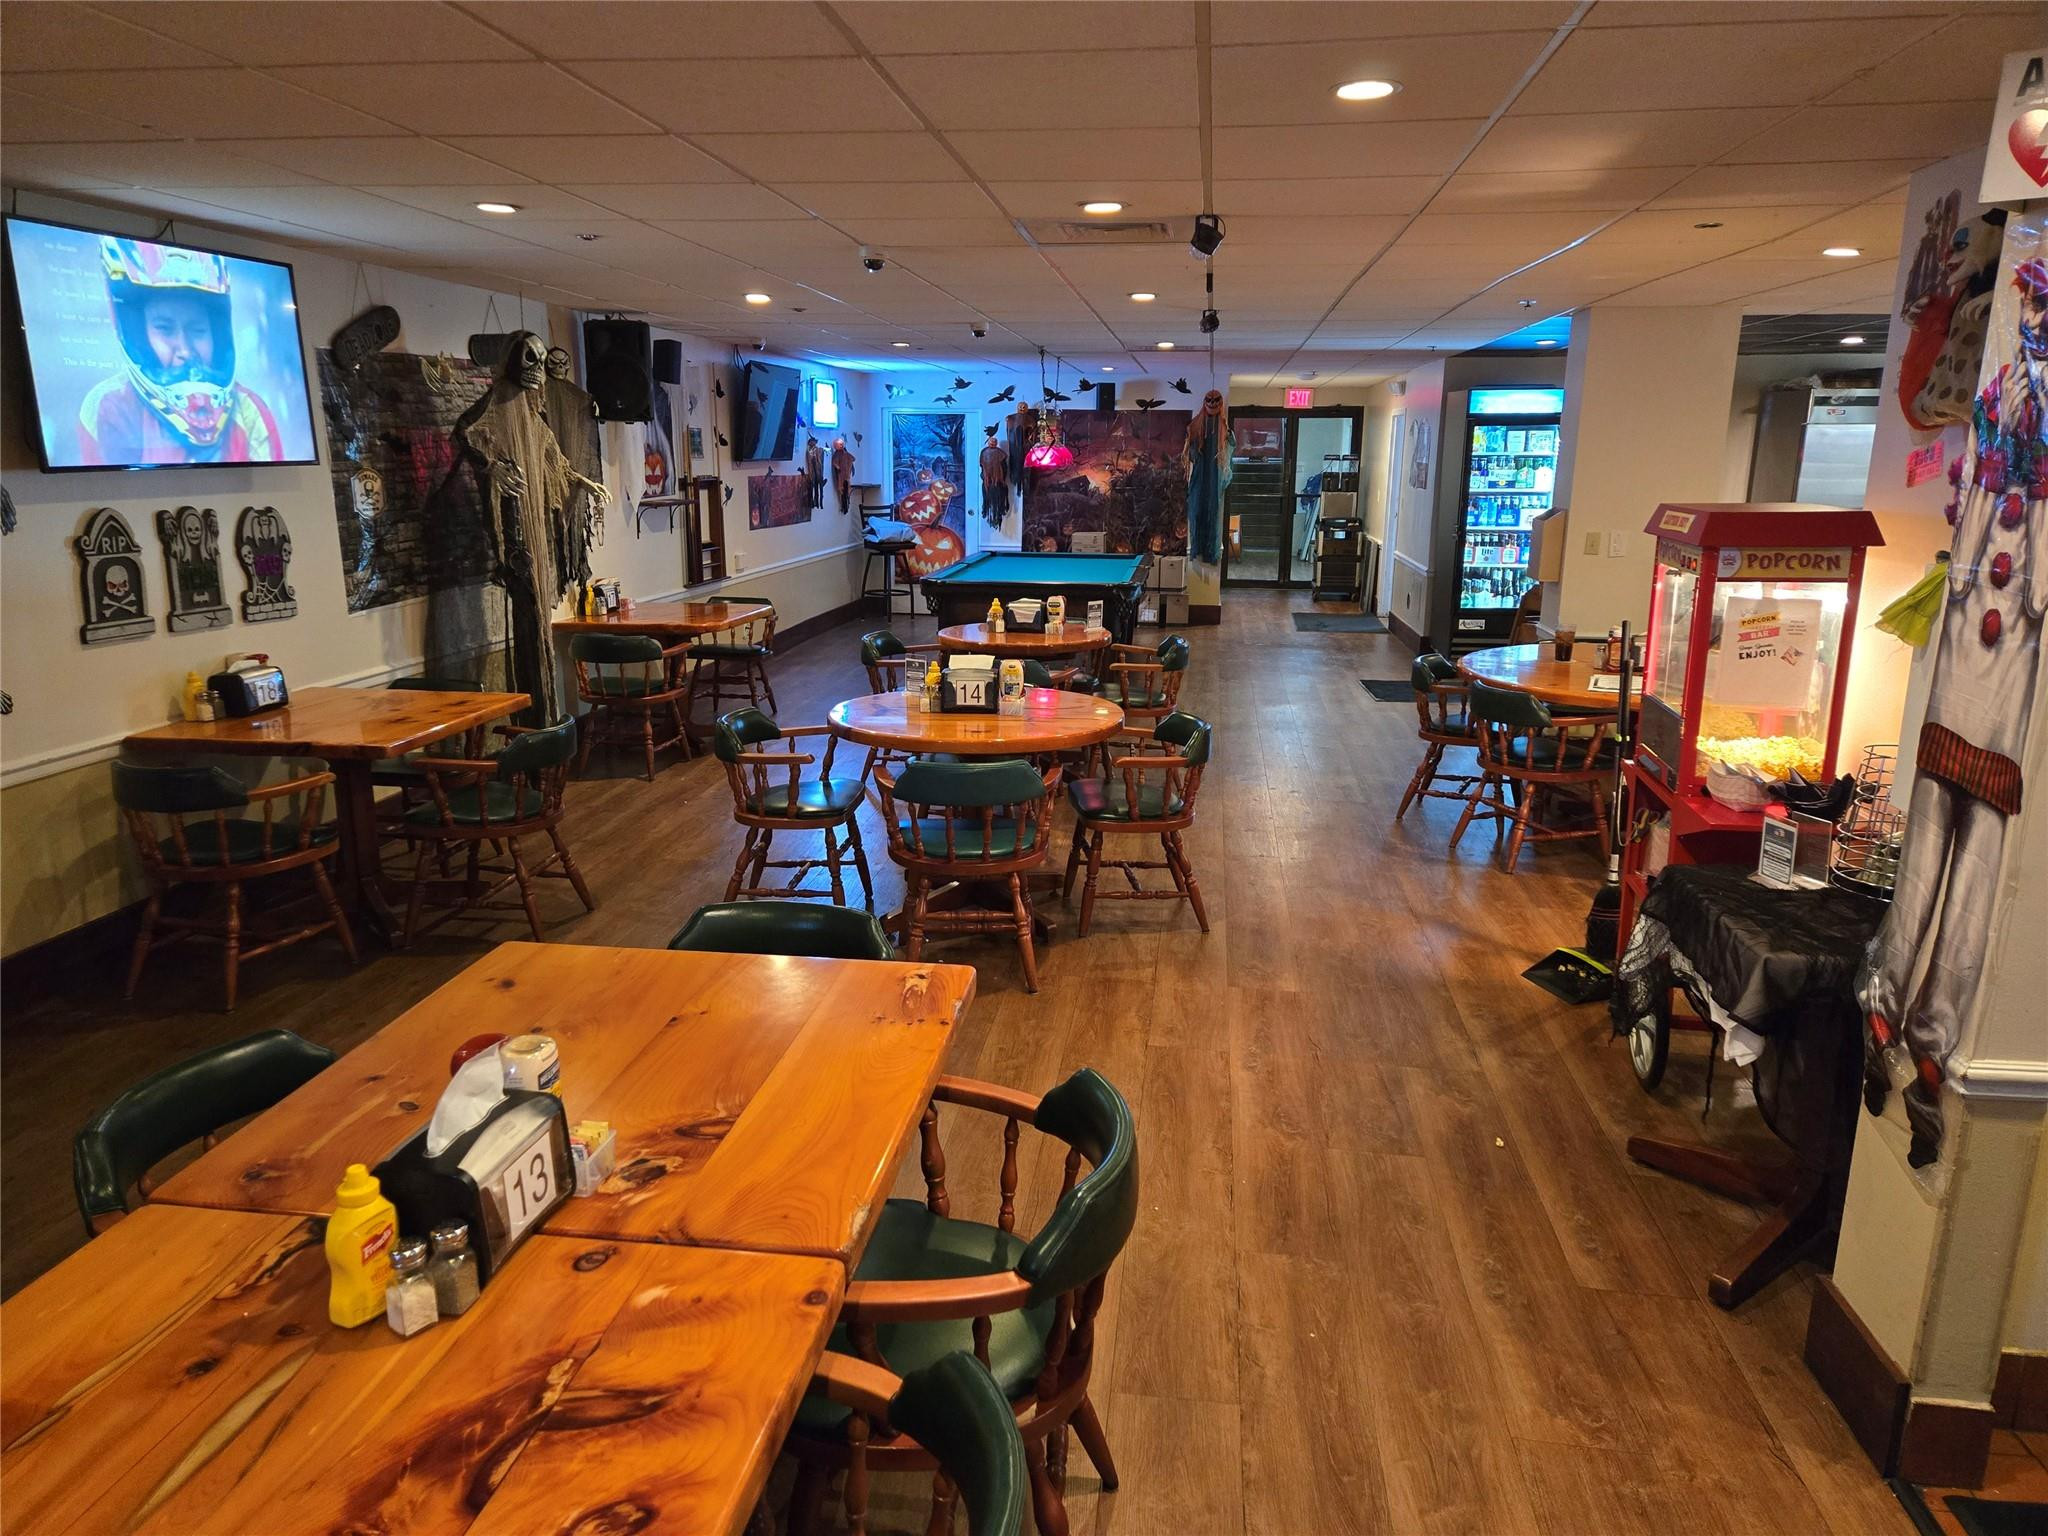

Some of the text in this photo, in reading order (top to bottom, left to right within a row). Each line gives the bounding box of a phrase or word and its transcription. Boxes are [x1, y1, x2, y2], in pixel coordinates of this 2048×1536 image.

[1289, 390, 1311, 406] EXIT
[101, 535, 128, 554] RIP
[1747, 552, 1841, 571] POPCORN
[1741, 615, 1777, 626] POPCORN
[1750, 630, 1769, 639] BAR
[1739, 649, 1777, 660] ENJOY!
[258, 680, 276, 703] 18
[960, 683, 982, 704] 14
[513, 1153, 549, 1219] 13
